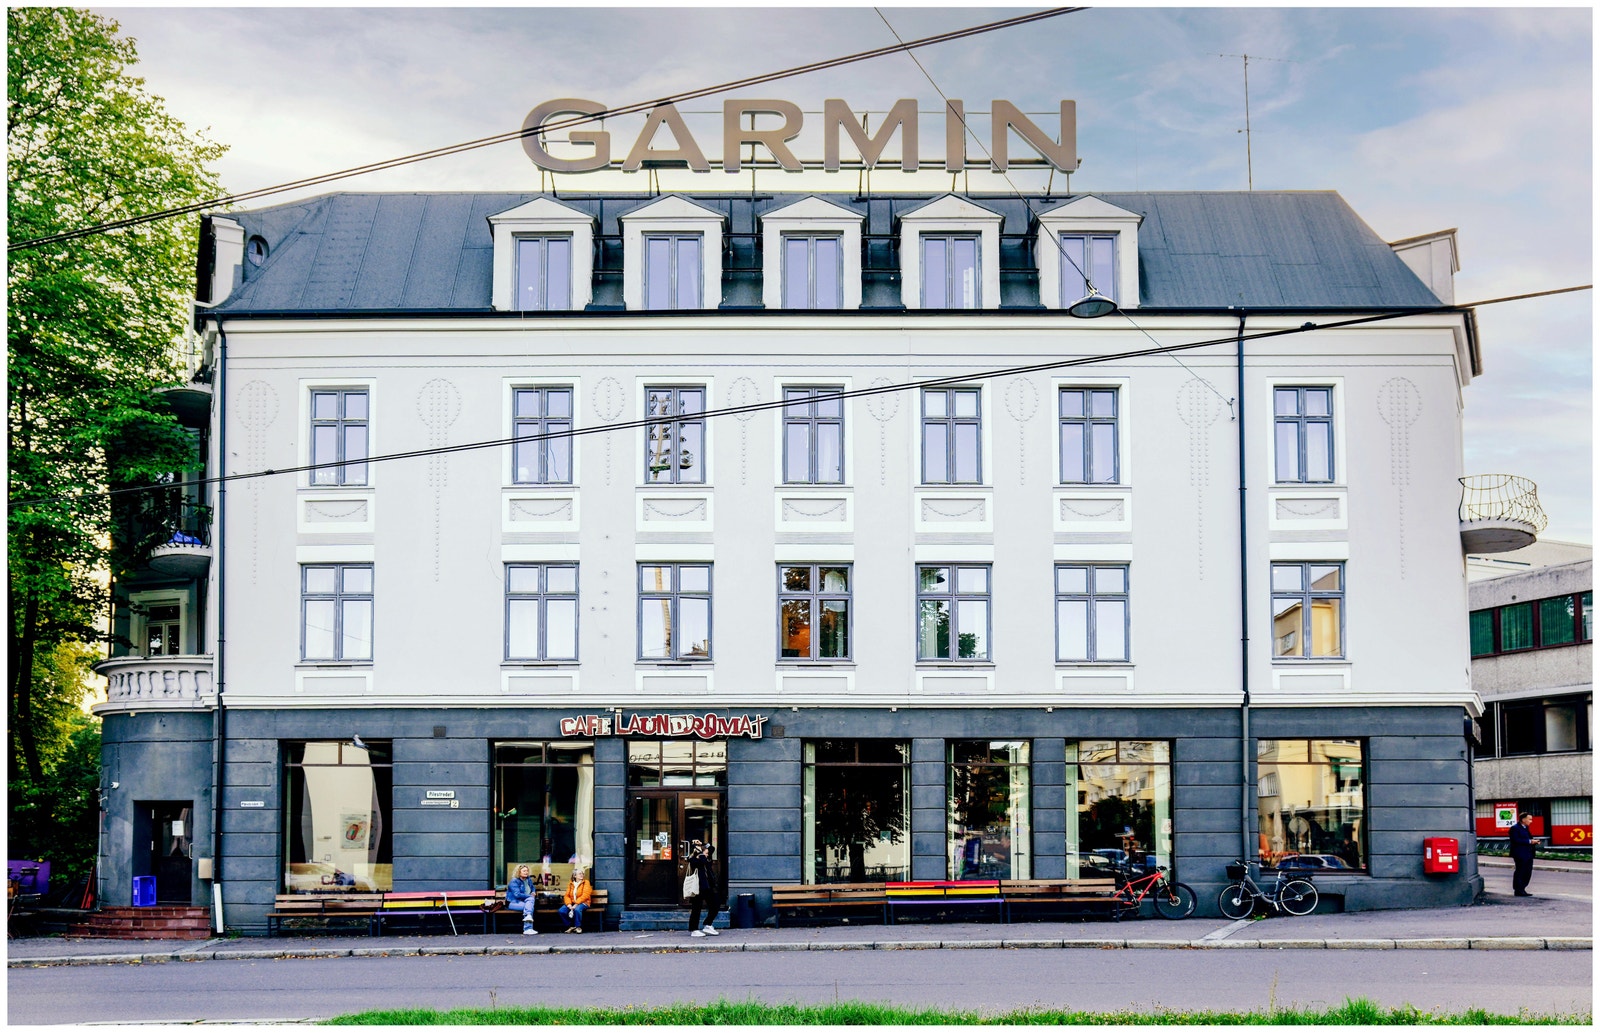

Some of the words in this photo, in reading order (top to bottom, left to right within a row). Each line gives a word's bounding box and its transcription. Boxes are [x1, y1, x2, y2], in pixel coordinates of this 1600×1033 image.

[521, 98, 1077, 174] GARMIN
[560, 715, 611, 736] CAFE
[615, 712, 768, 738] LAUNDROMAT
